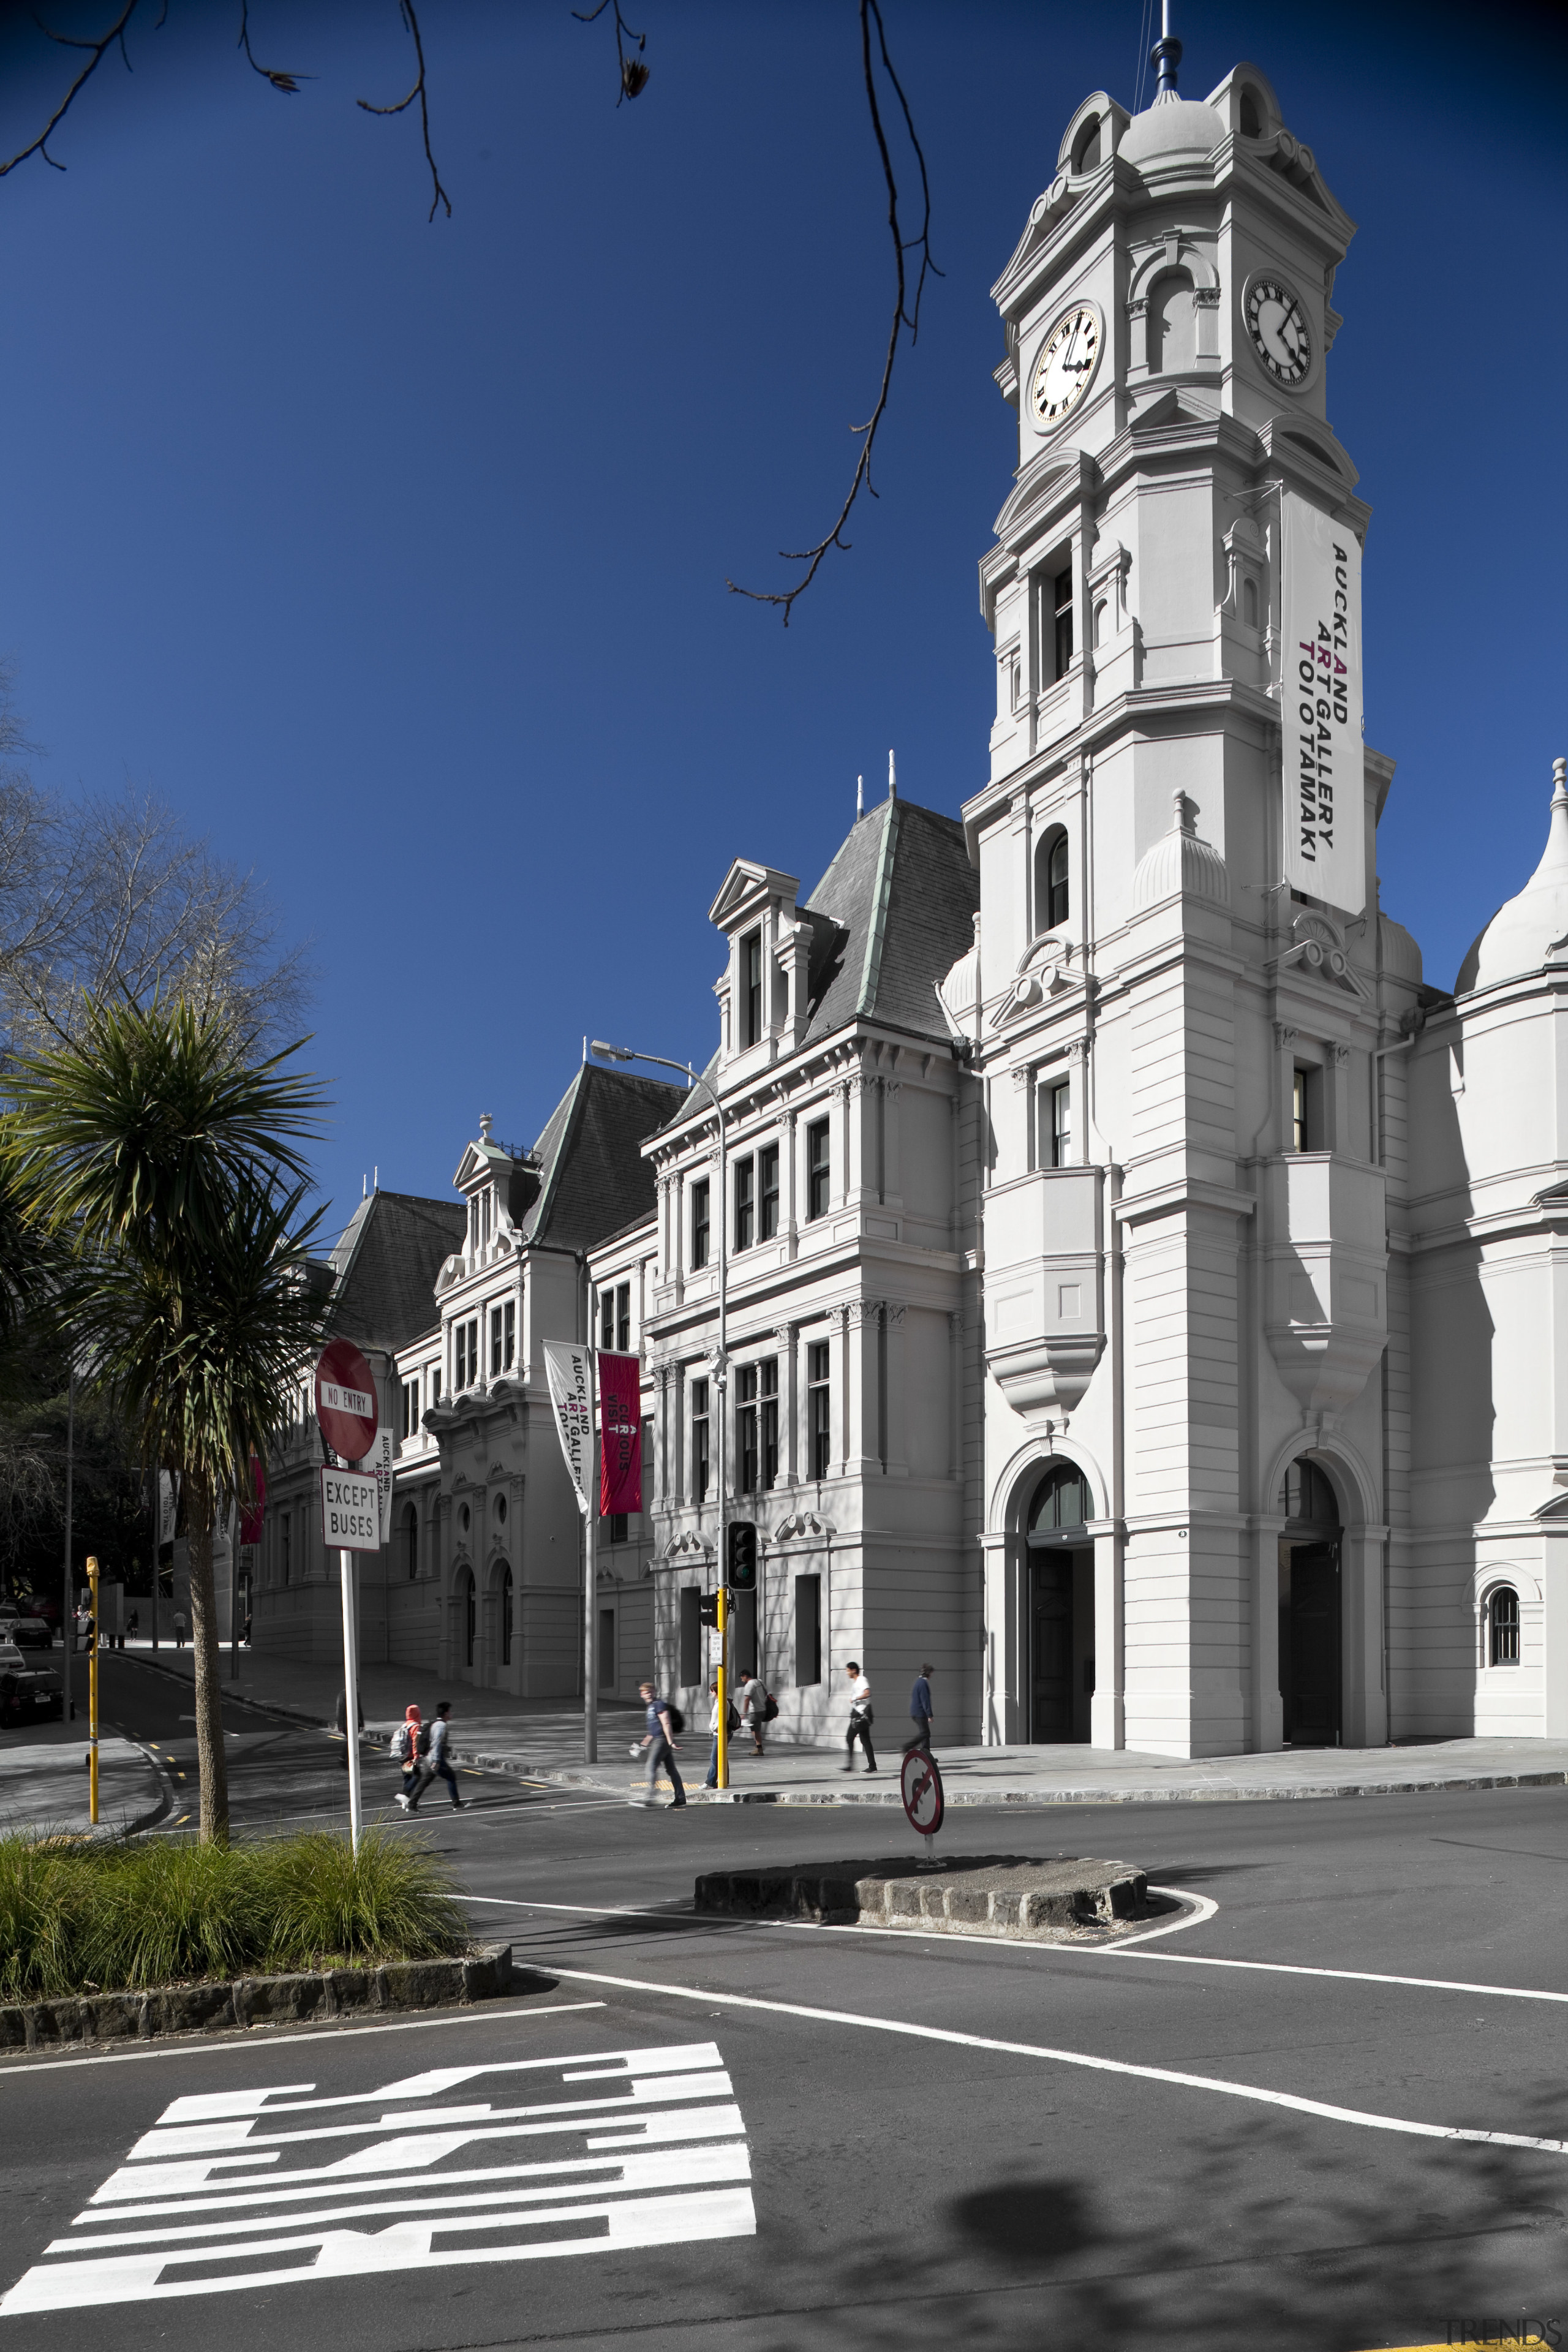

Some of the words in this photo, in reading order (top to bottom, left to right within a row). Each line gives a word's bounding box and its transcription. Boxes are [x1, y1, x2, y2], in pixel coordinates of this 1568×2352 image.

[1317, 620, 1332, 696] ART
[1332, 542, 1348, 725] AUCKLAND
[1299, 641, 1315, 695] TOI
[1298, 703, 1314, 725] O
[1316, 699, 1333, 849] GALLERY
[328, 1386, 338, 1406] NO
[344, 1391, 366, 1412] ENTRY
[567, 1392, 580, 1423] ART
[571, 1355, 590, 1436] AUCKLAND
[607, 1394, 619, 1434] VISIT
[619, 1404, 630, 1471] CURIOUS
[630, 1425, 638, 1435] A
[382, 1435, 390, 1492] AUCKLAND
[326, 1481, 375, 1509] EXCEPT
[331, 1512, 373, 1537] BUSES
[0, 2041, 758, 2316] BUSES
